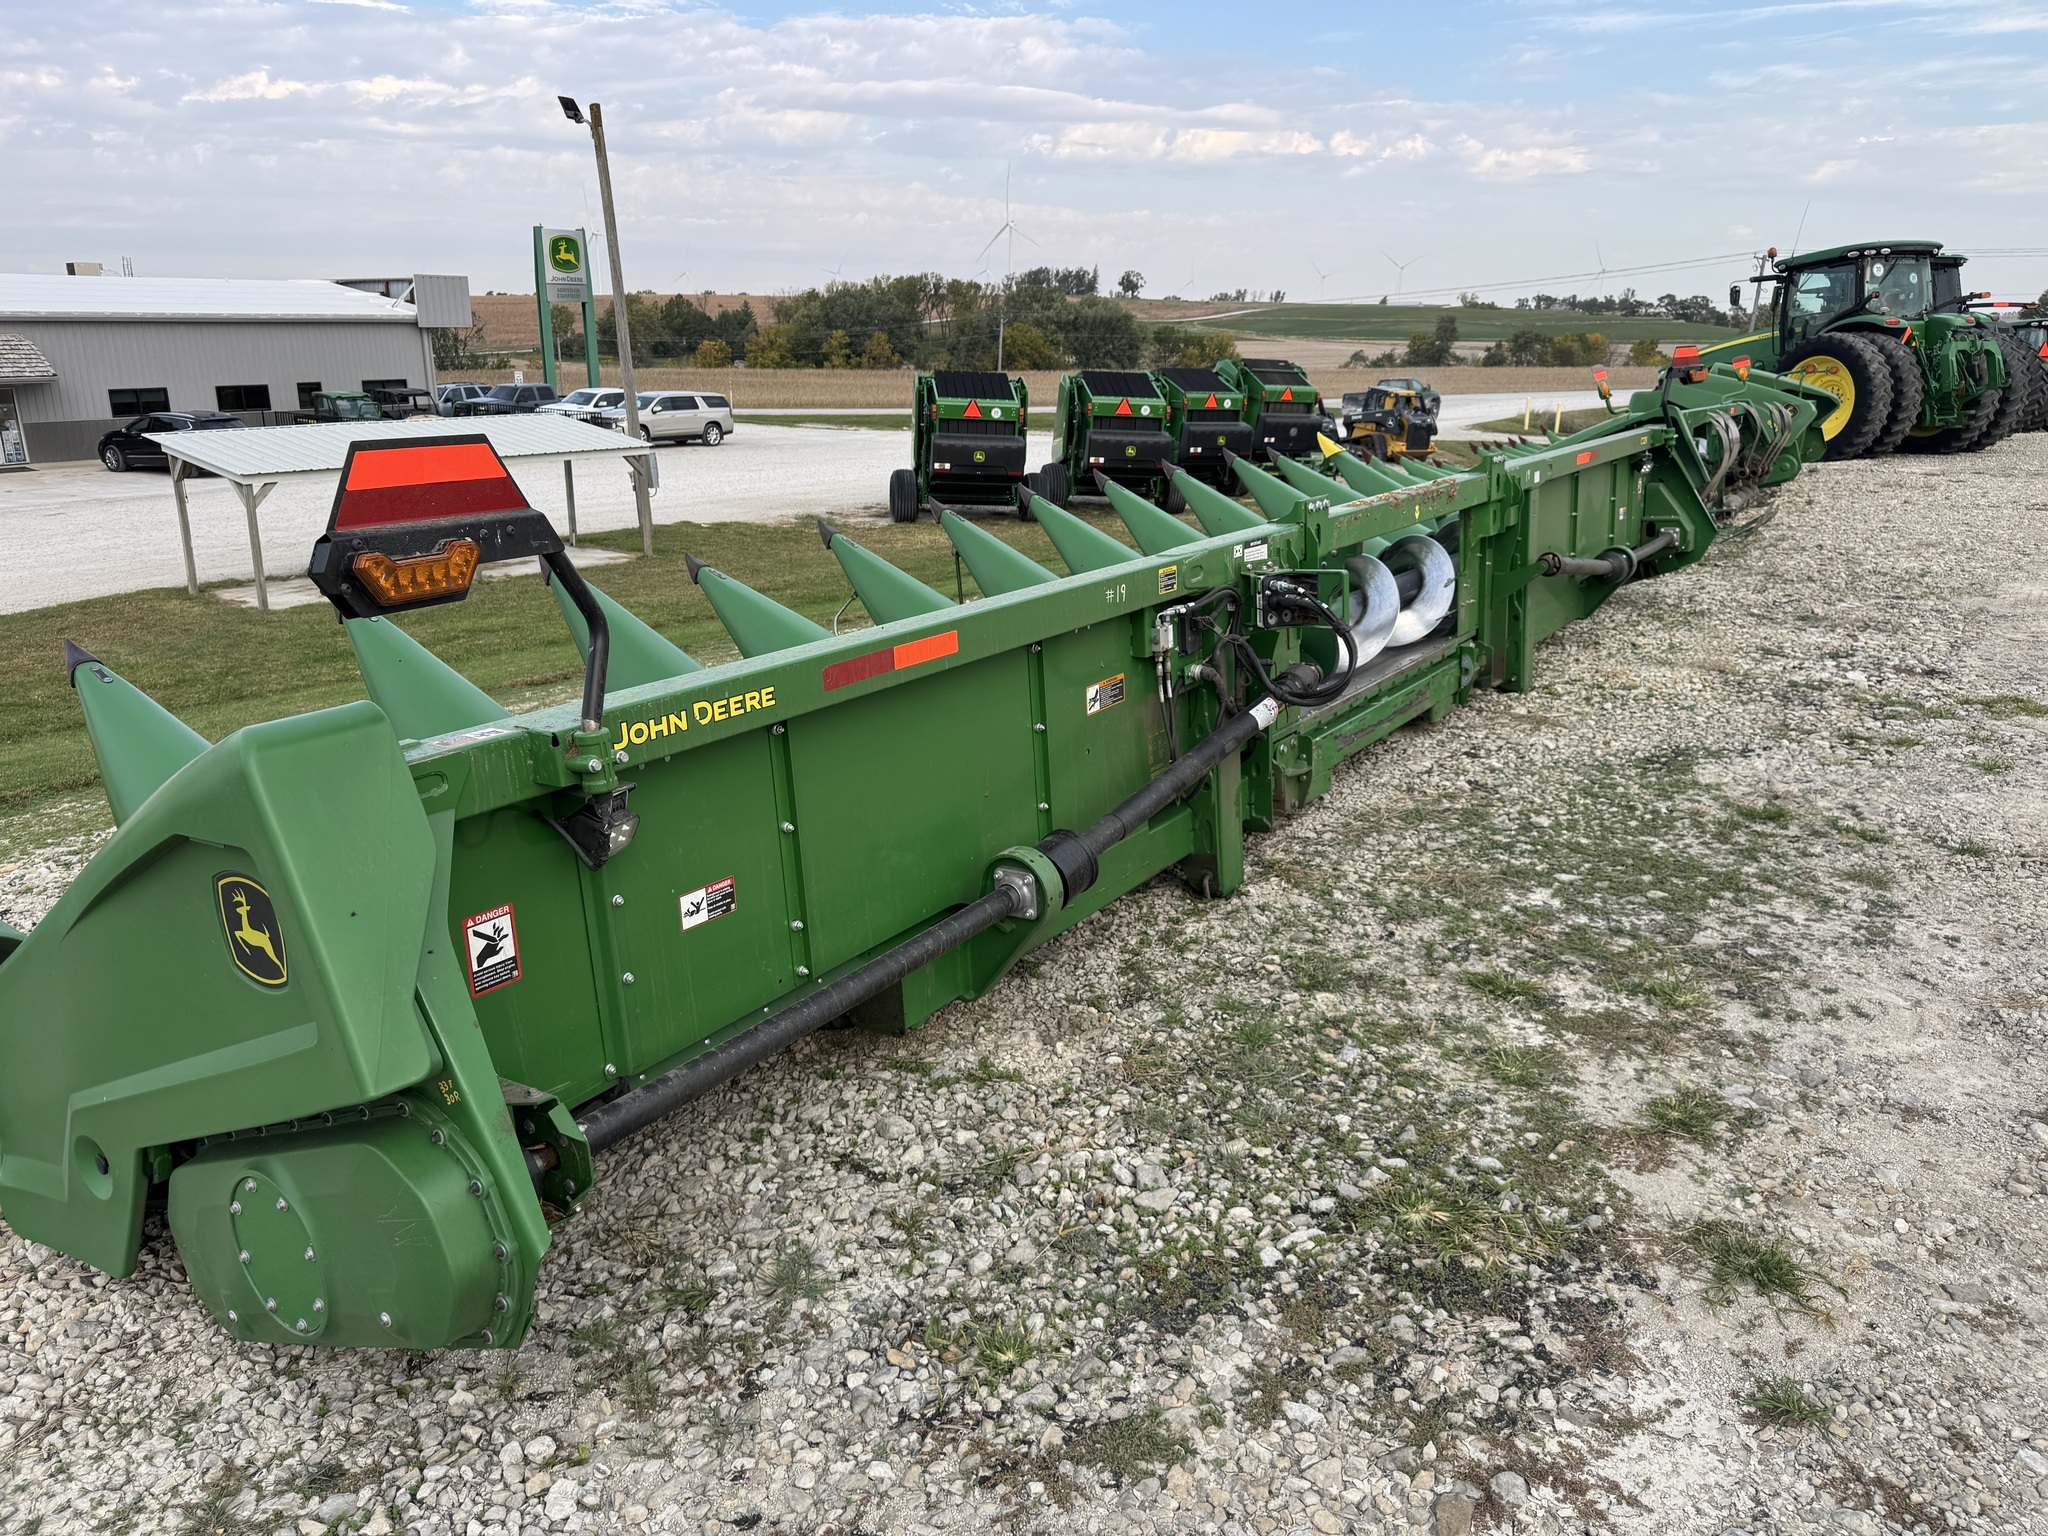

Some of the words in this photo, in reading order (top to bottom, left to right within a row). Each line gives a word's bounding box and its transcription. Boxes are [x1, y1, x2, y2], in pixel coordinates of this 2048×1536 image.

[1105, 583, 1127, 603] #19
[613, 710, 688, 751] JOHN
[692, 686, 775, 726] DEERE
[713, 879, 730, 890] DANGER
[476, 906, 509, 923] DANGER
